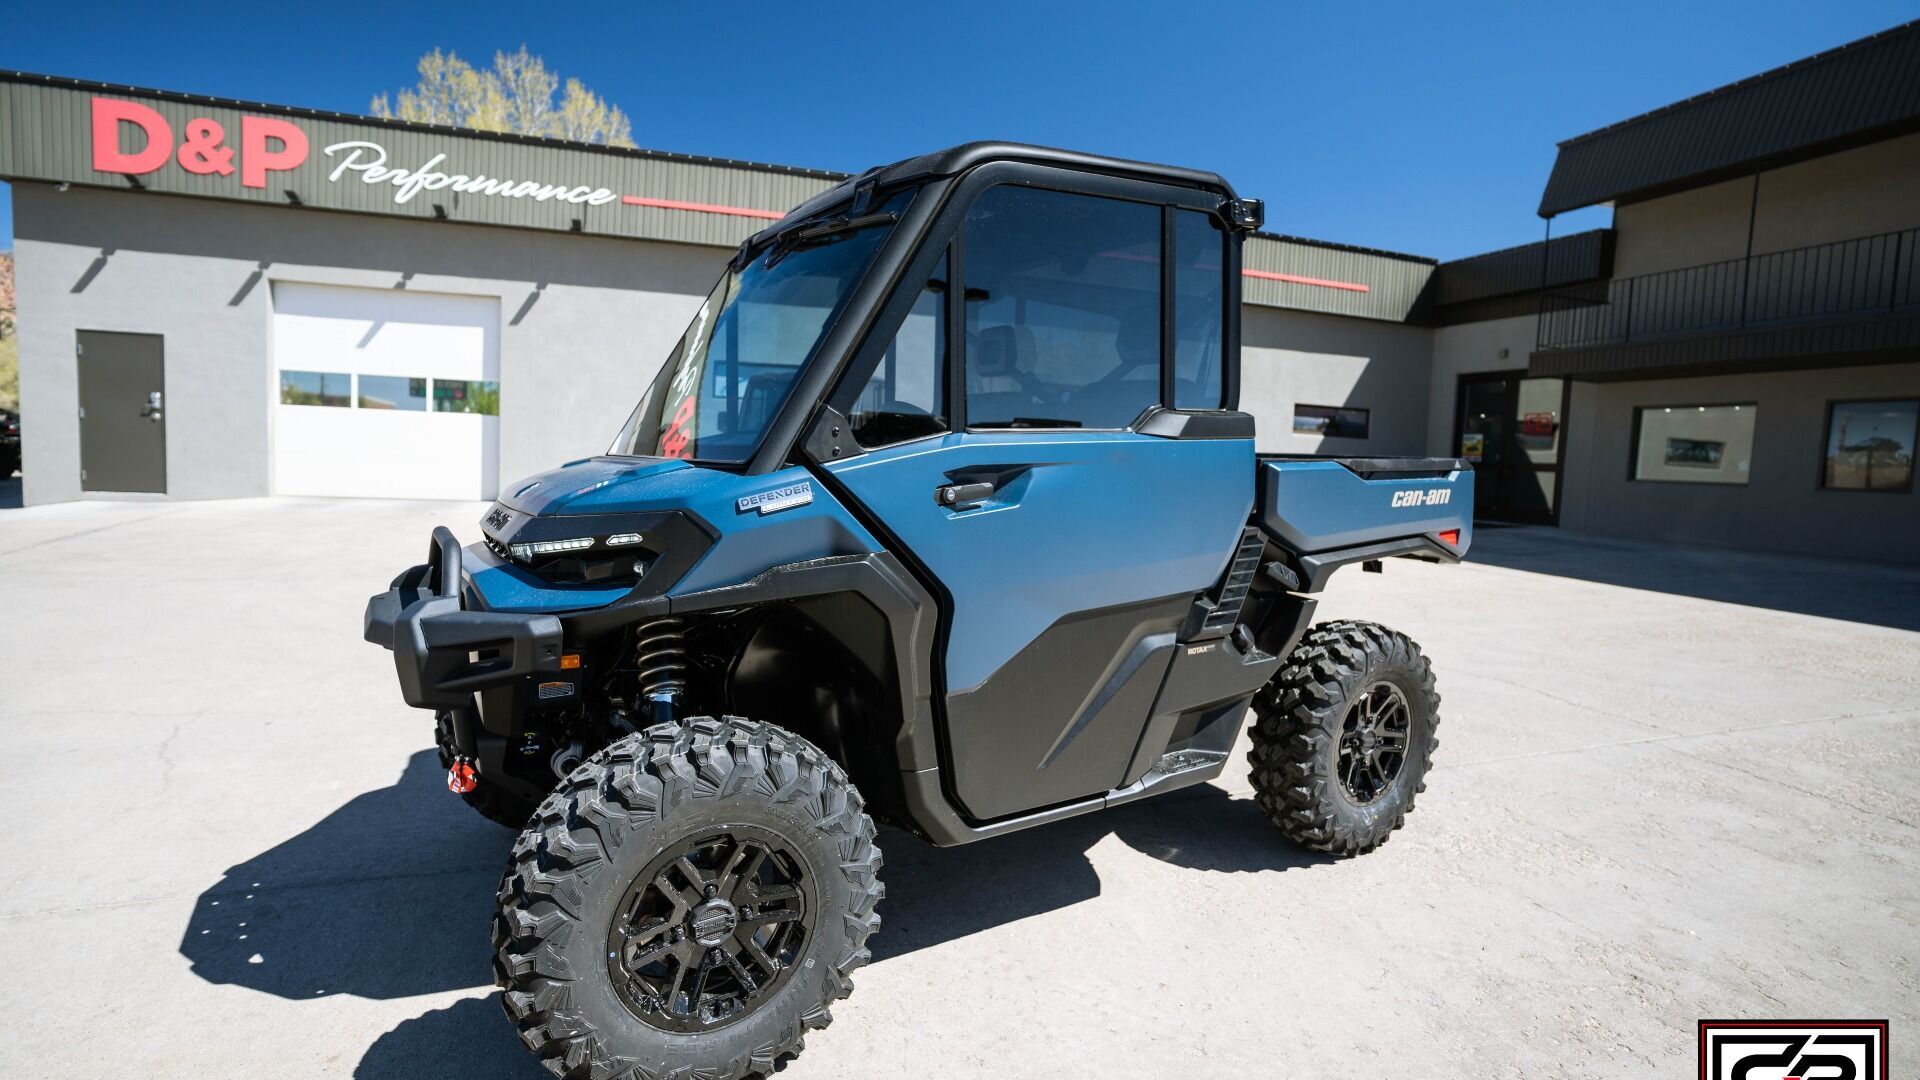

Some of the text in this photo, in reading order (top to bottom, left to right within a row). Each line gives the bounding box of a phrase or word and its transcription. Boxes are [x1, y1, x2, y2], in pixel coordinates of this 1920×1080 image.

[91, 96, 309, 188] D&P
[324, 141, 617, 205] Performance
[741, 484, 810, 507] DEFENDER
[1391, 488, 1451, 508] can-am
